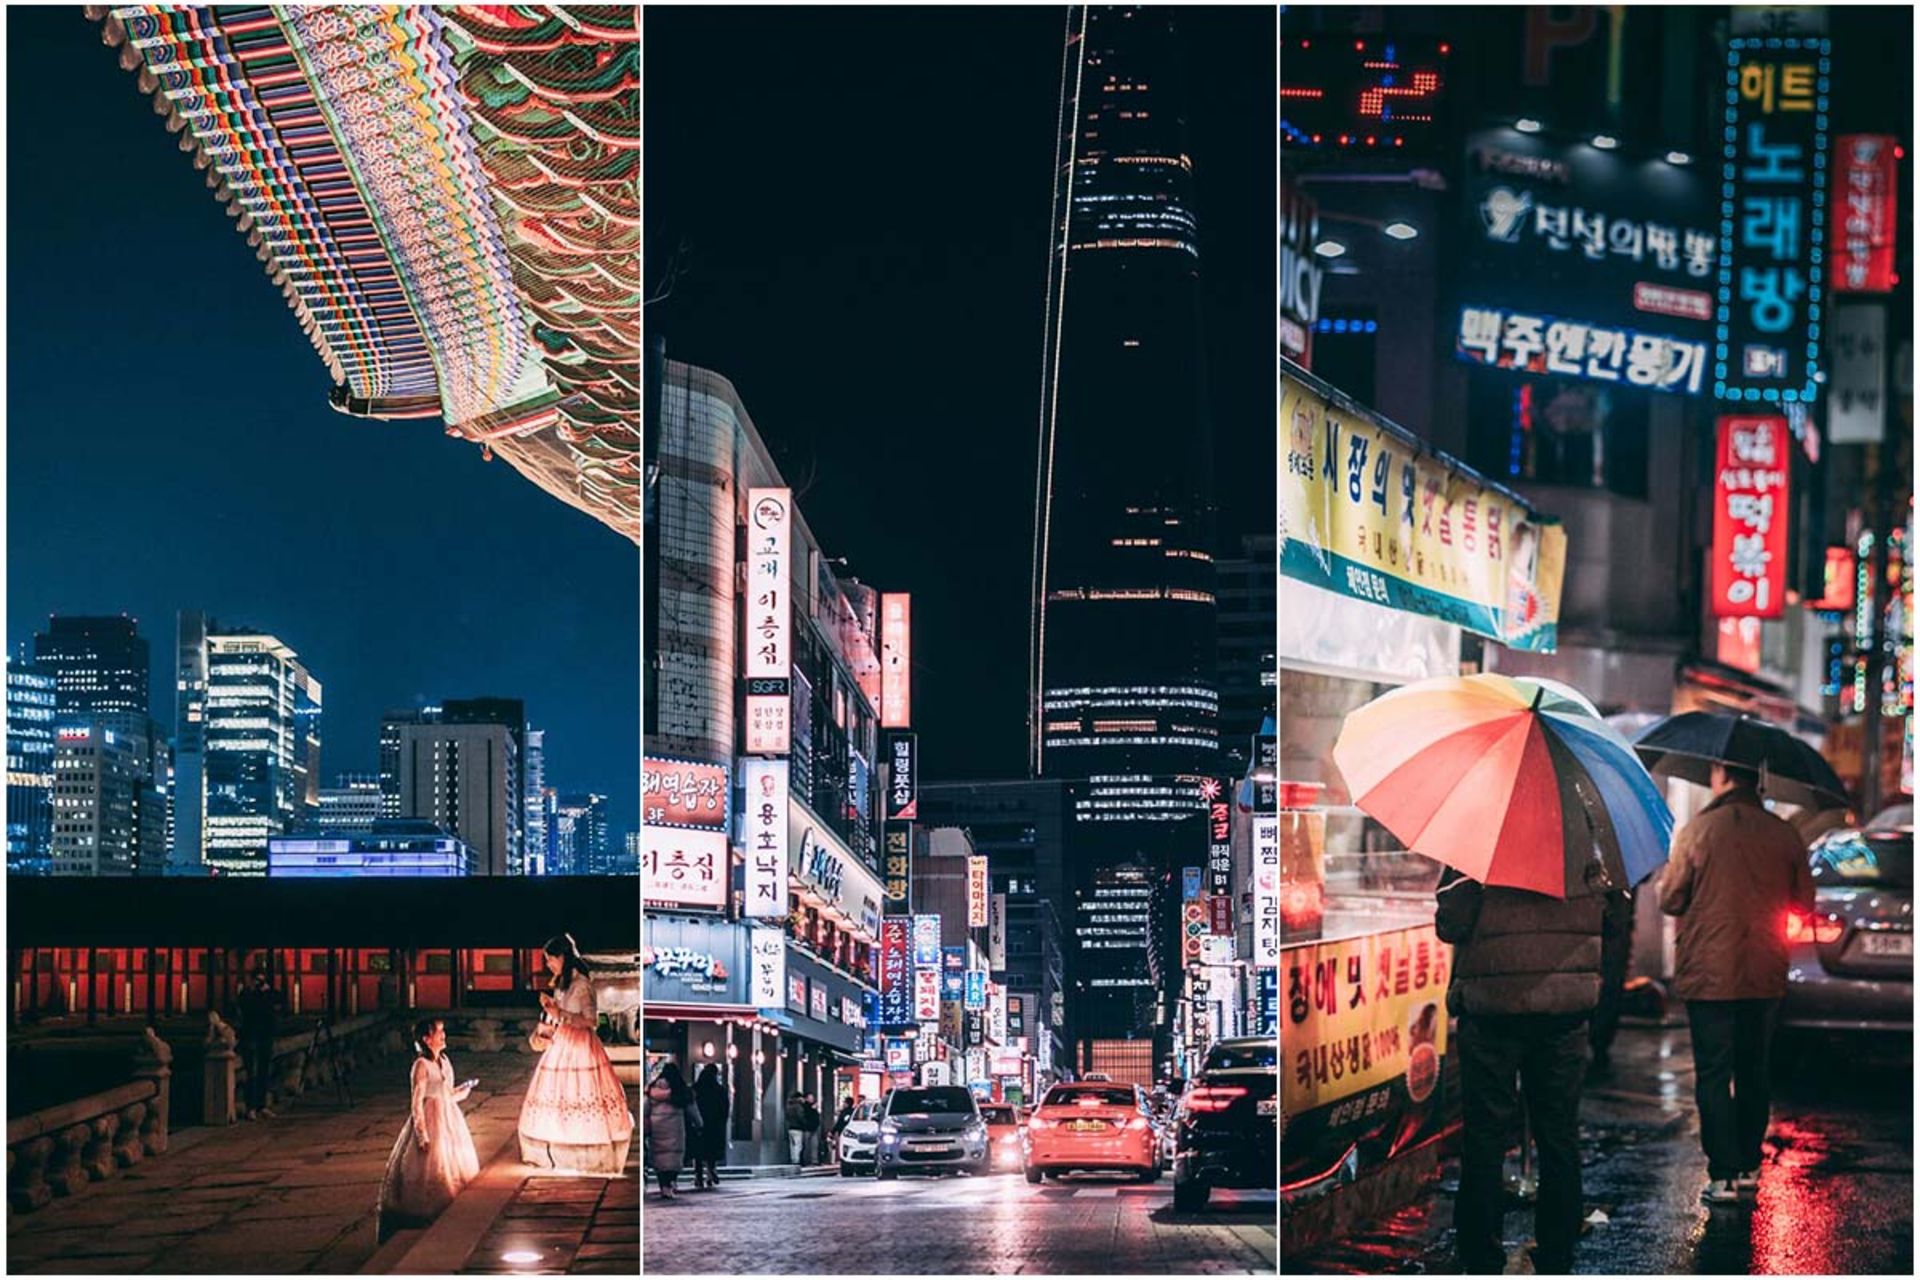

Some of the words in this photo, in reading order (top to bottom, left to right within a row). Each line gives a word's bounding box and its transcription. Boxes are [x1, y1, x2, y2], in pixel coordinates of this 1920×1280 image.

[1741, 62, 1815, 113] 히트
[1741, 122, 1805, 332] 노래방
[1727, 493, 1773, 611] 떡볶이
[648, 807, 665, 820] 3F
[755, 803, 779, 902] 용호낙지
[887, 832, 909, 900] 전화방
[971, 870, 985, 922] 타이마사지
[1214, 874, 1227, 885] B1
[890, 1051, 902, 1065] P
